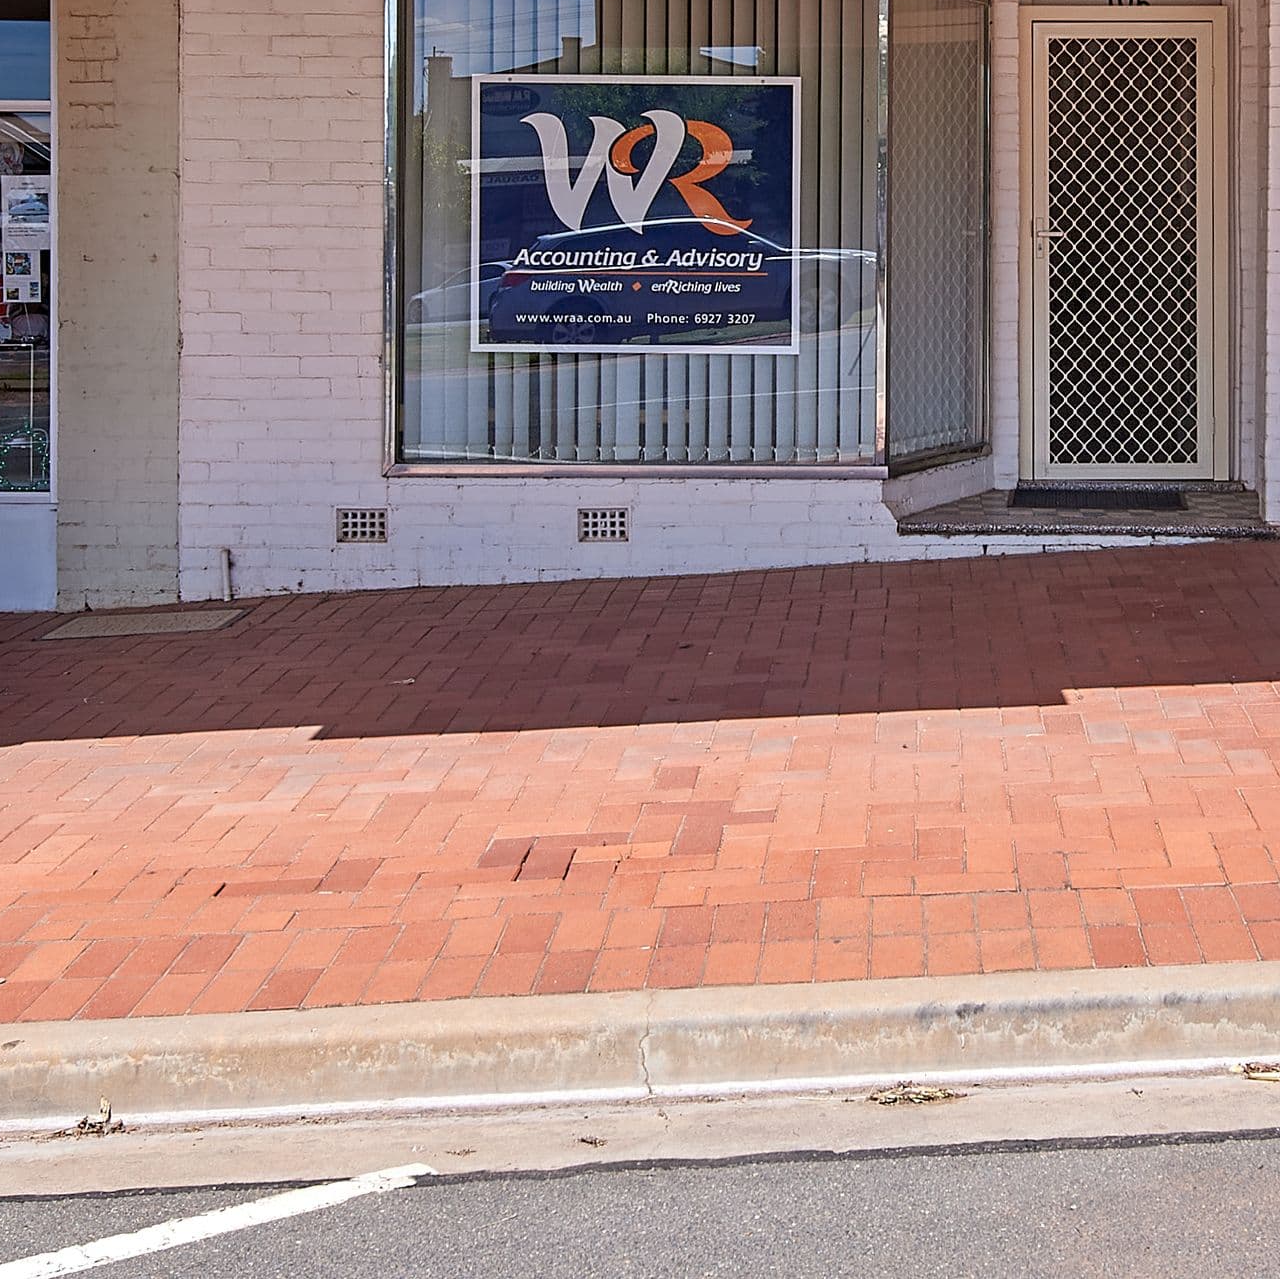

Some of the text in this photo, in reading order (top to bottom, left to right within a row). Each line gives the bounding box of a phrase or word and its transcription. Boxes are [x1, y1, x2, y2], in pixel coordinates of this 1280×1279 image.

[513, 247, 763, 272] Accounting & Advisory
[530, 279, 741, 295] building Wealth enRiching lives
[515, 313, 756, 324] www.wraa.com.au Phone: 6927 3207
